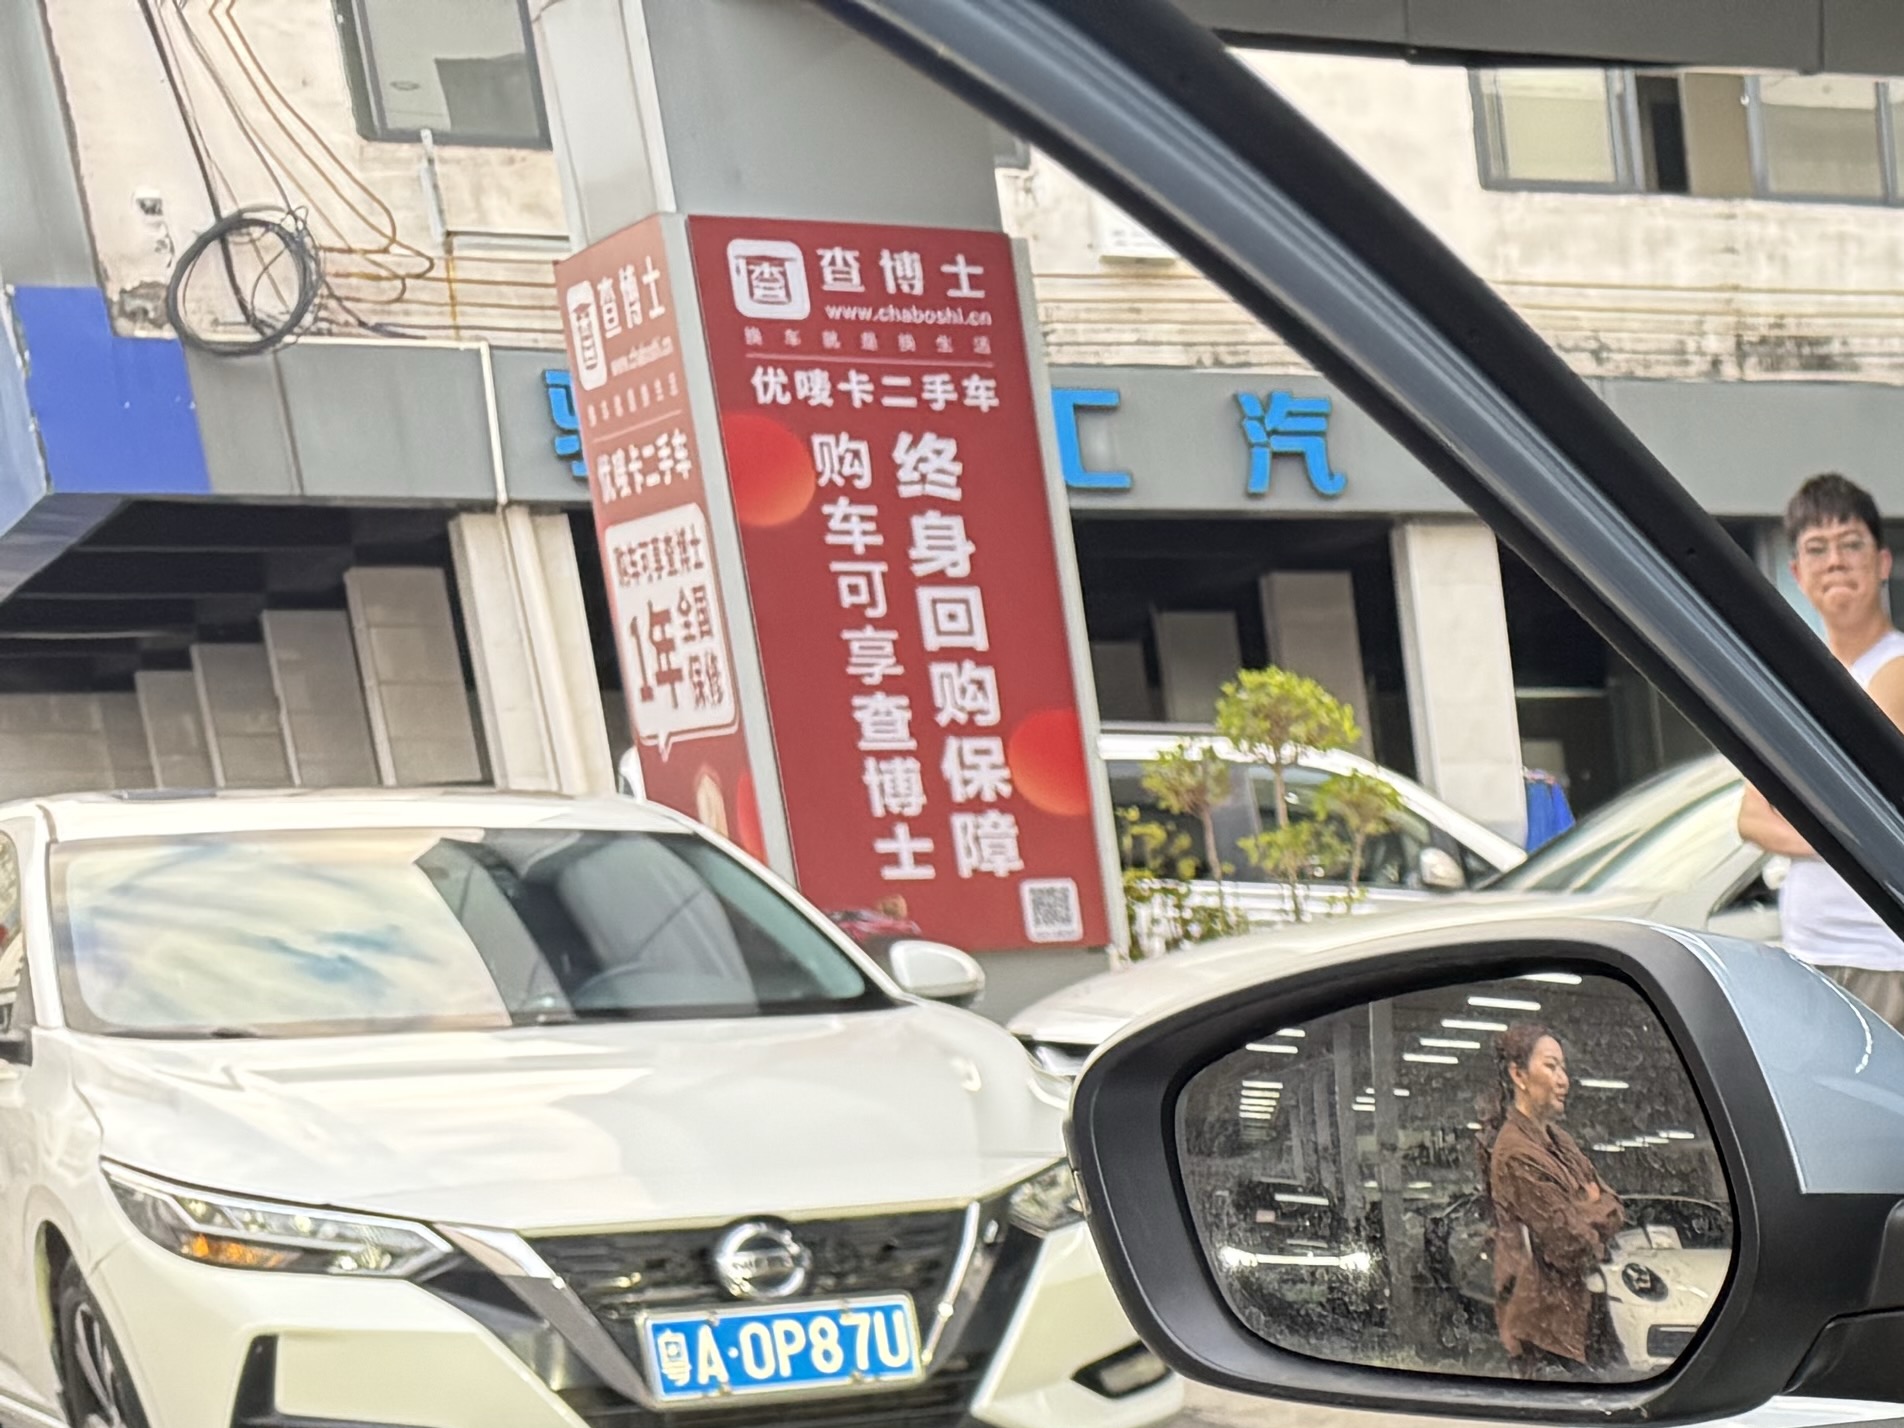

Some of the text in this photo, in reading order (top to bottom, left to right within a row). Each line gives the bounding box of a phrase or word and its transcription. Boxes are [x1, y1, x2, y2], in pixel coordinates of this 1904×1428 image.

[816, 246, 986, 298] 查博士
[825, 304, 992, 326] www.chaboshi.cn
[811, 432, 936, 880] 购车可享查博士
[891, 431, 1026, 878] 终身回购保障
